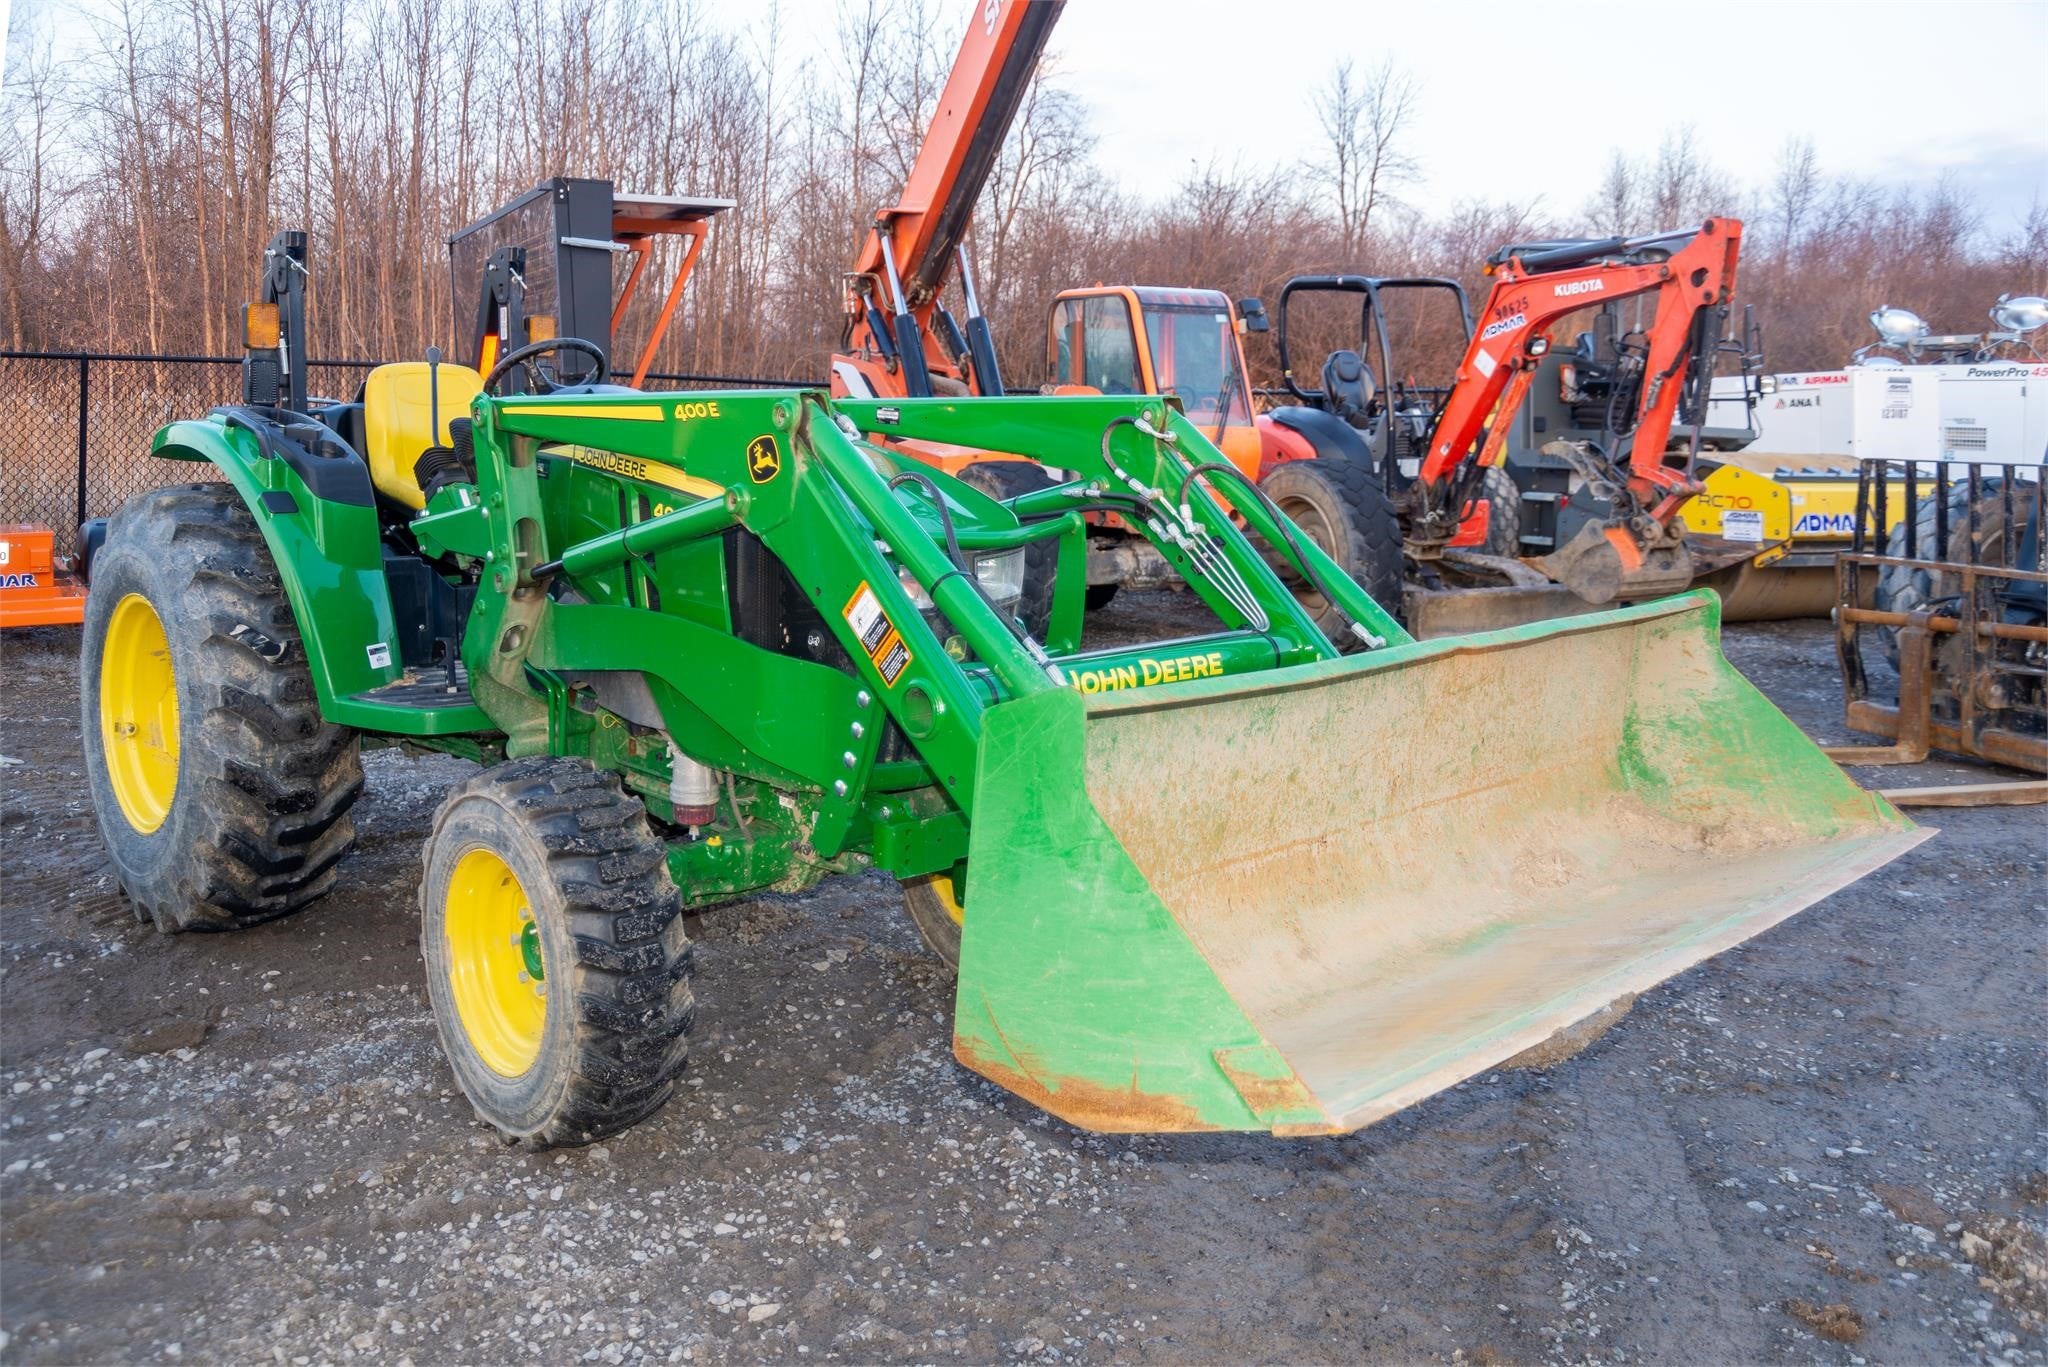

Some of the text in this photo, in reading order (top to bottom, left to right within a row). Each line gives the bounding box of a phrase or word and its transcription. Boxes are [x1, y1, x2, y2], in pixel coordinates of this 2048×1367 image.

[983, 0, 1004, 37] S
[1554, 279, 1604, 296] KUBOTA
[1483, 315, 1526, 338] ADMAR
[1967, 367, 2029, 377] PowerPro
[579, 448, 647, 479] JOHN DEERE
[1794, 514, 1868, 532] ADMA
[1069, 652, 1223, 694] JOHN DEERE
